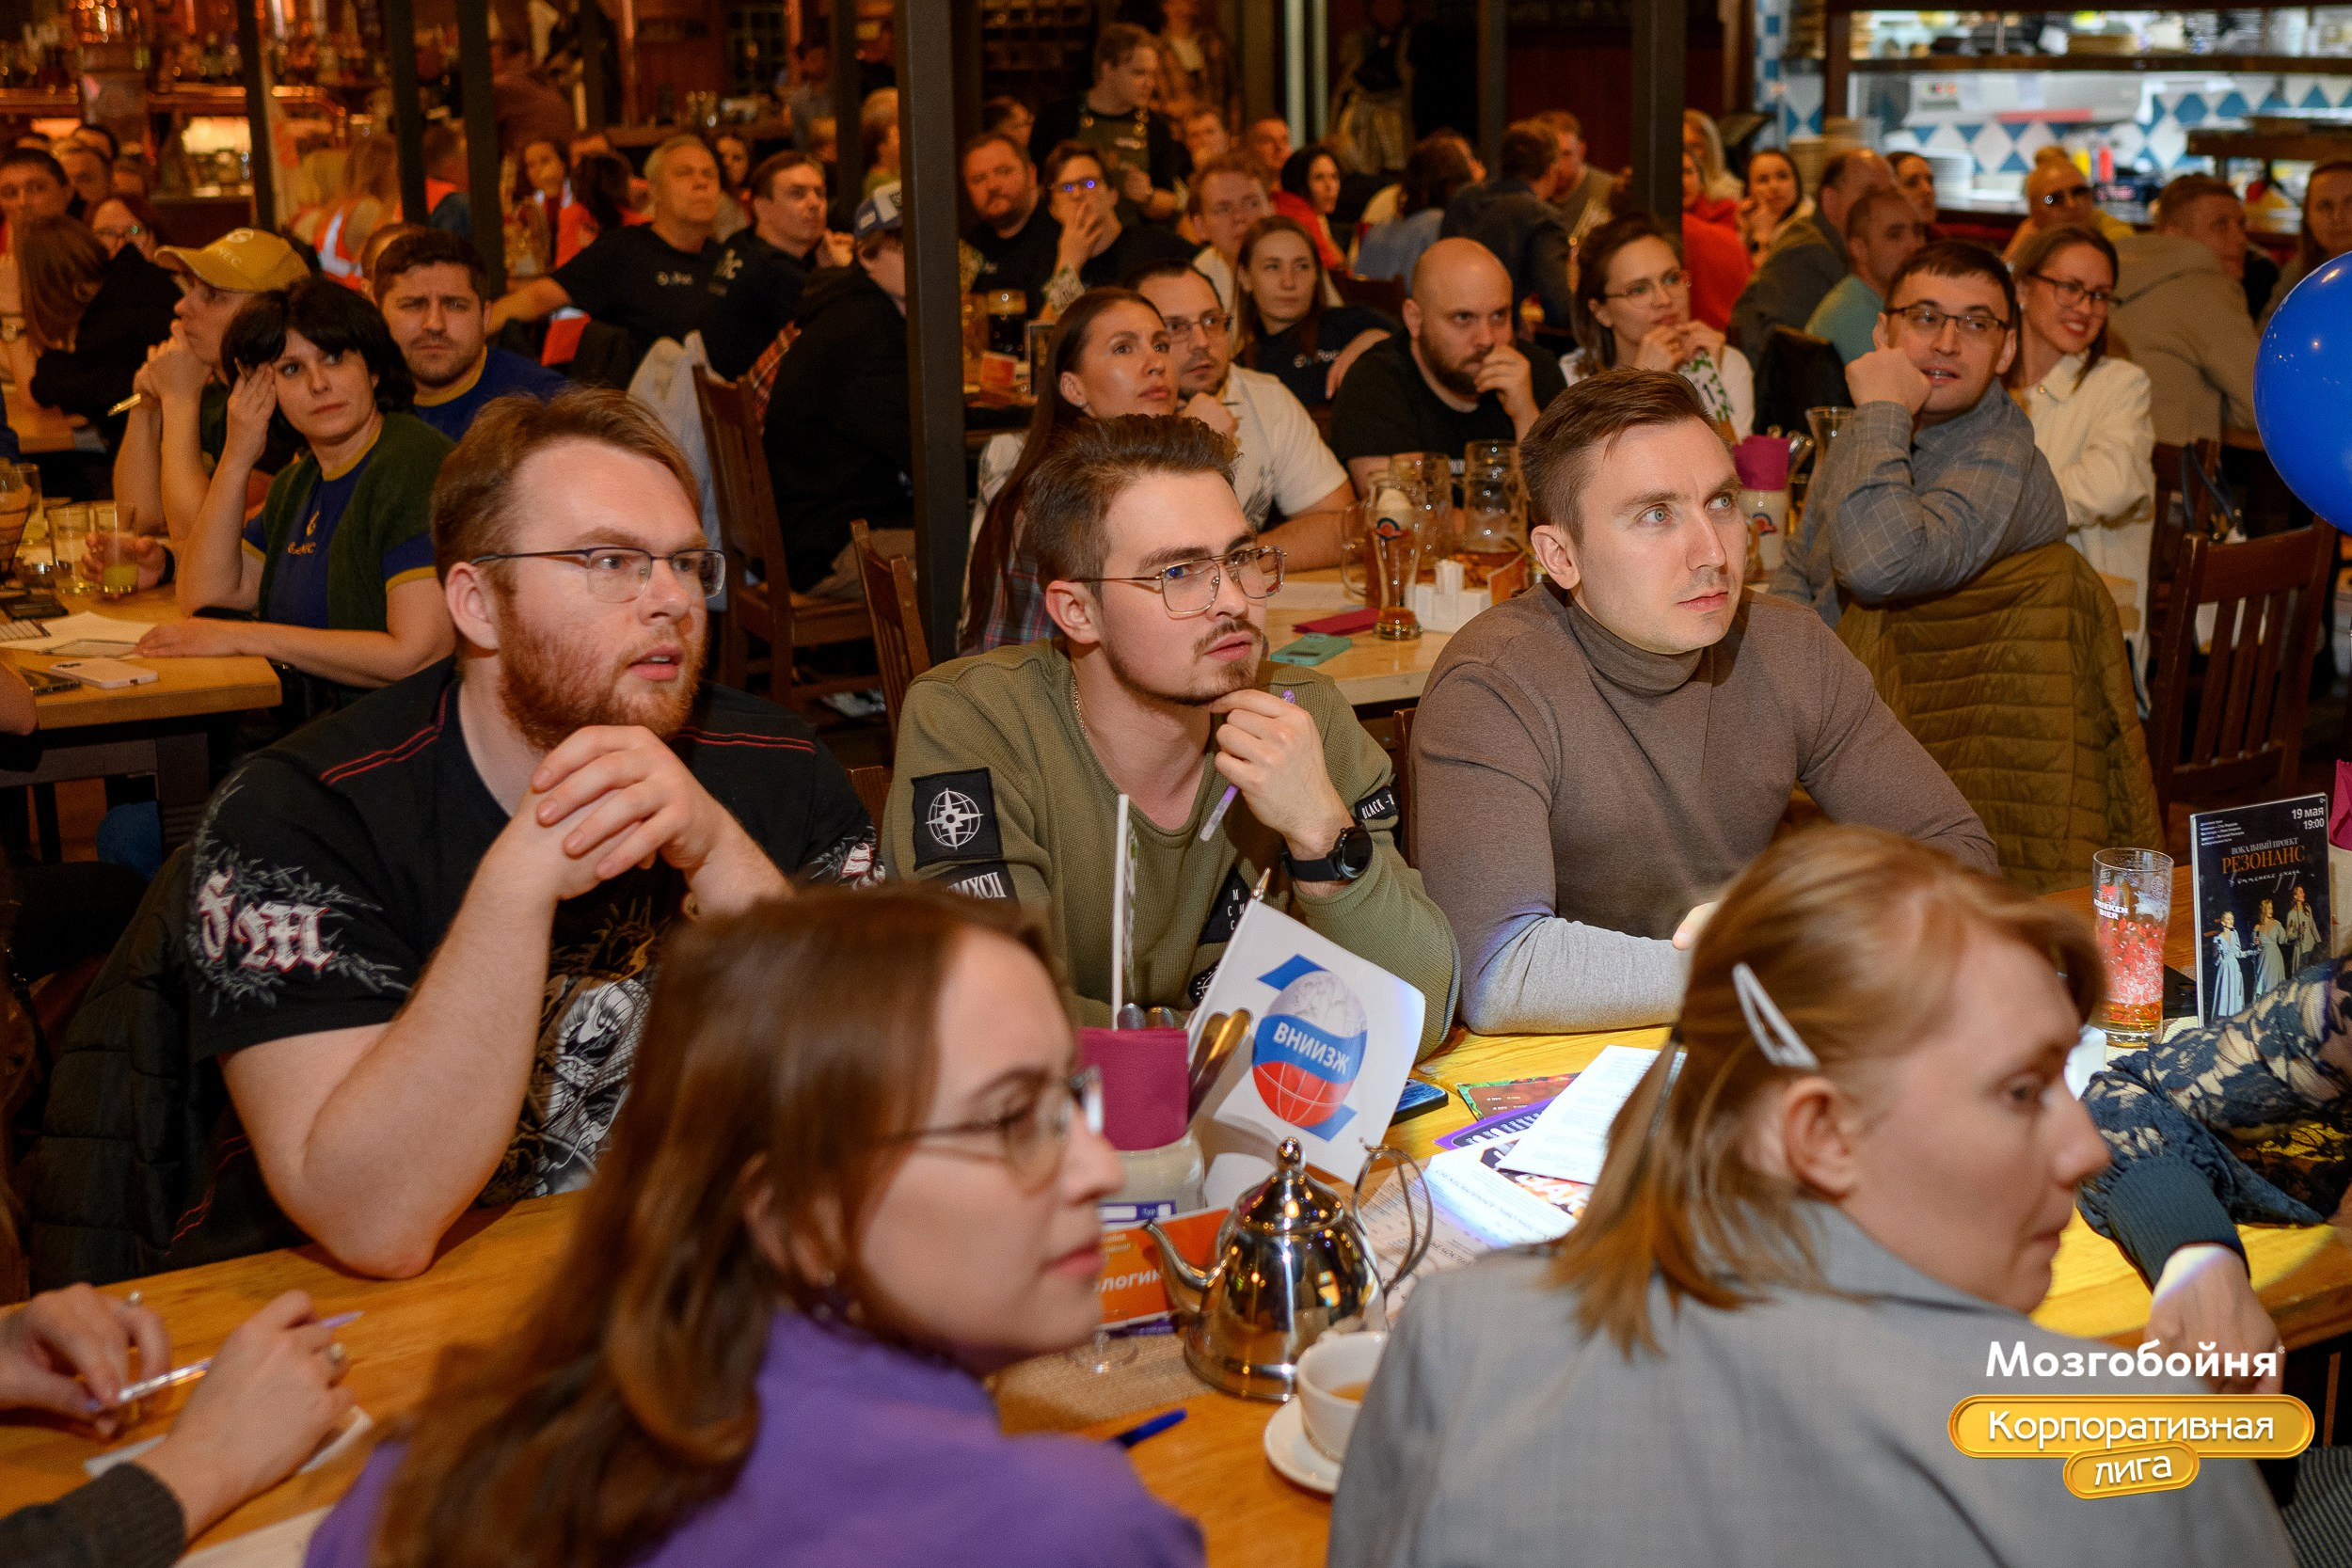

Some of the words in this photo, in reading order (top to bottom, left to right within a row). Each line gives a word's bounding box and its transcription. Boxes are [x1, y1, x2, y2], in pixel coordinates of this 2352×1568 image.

[2291, 808, 2303, 819] 19
[2304, 807, 2324, 817] мая
[2303, 817, 2325, 830] 19:00
[2221, 845, 2305, 874] РЕЗОНАНС
[1273, 1022, 1351, 1075] ВНИИЗЖ
